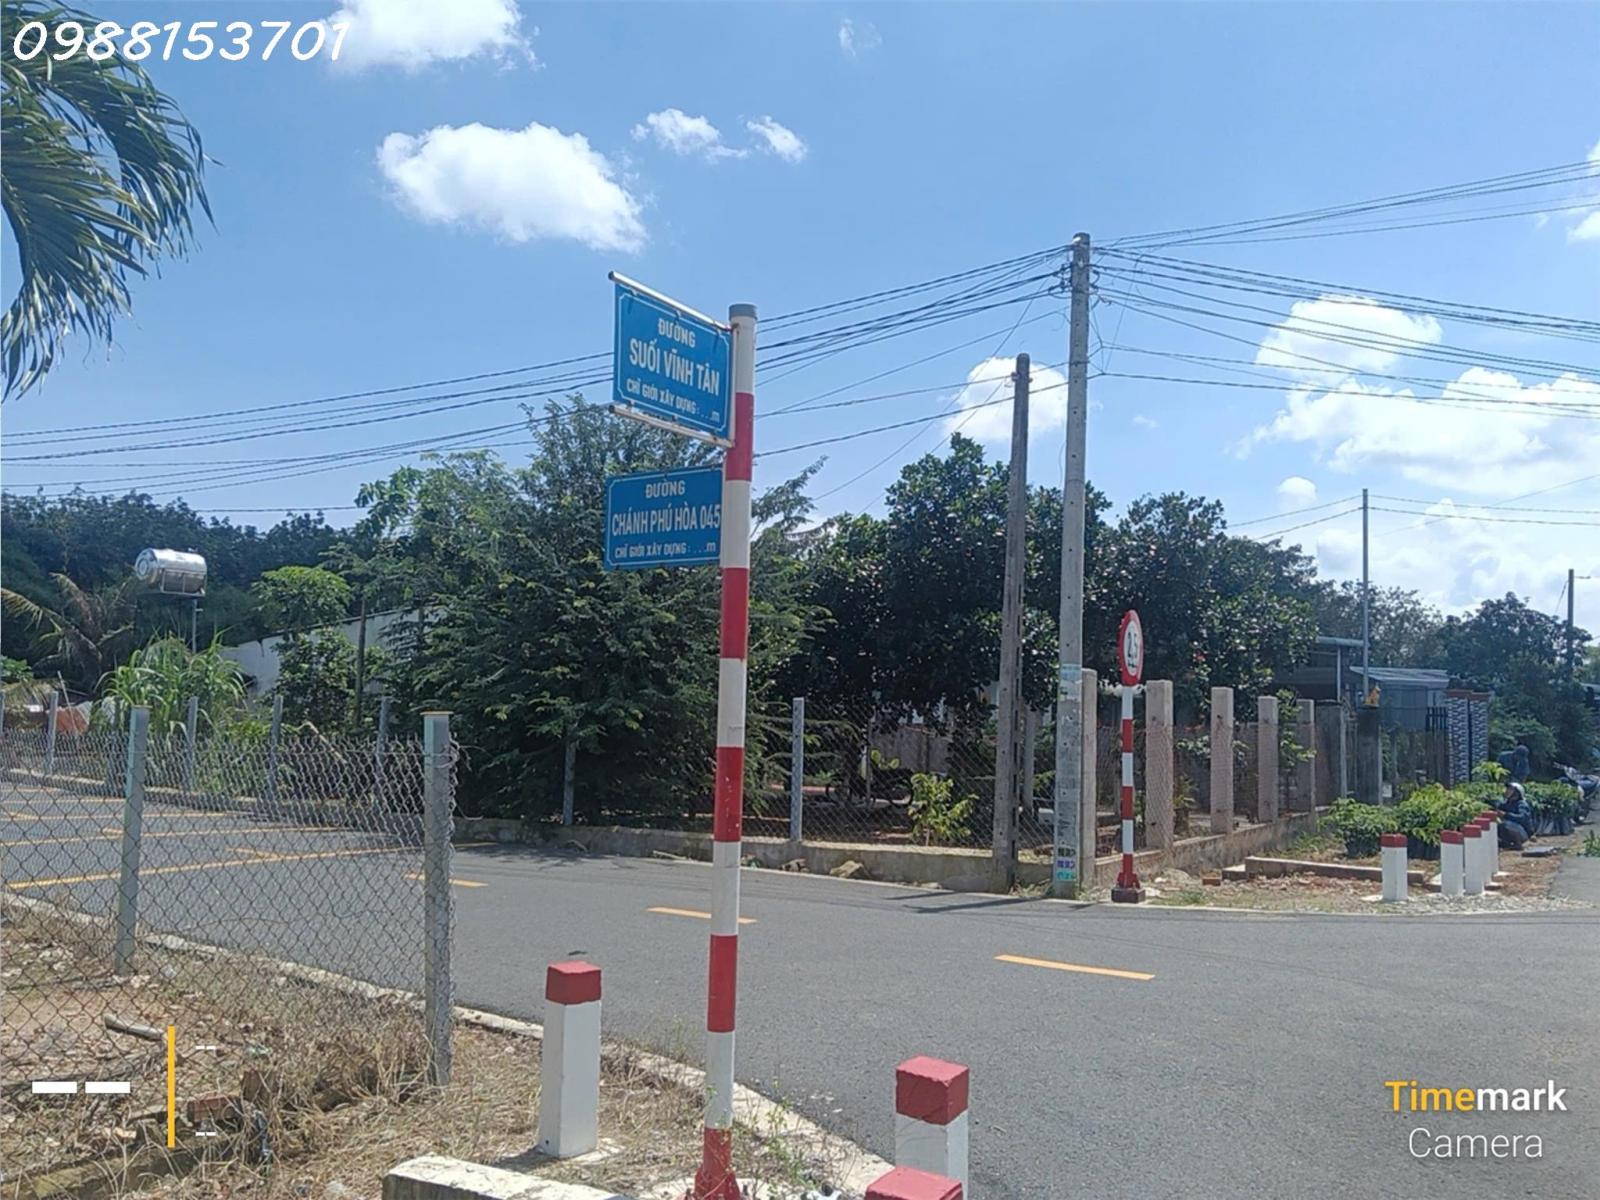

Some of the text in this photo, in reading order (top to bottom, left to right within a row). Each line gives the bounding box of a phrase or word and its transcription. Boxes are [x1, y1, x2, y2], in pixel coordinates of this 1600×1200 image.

[658, 318, 696, 348] ĐƯỜNG
[629, 338, 660, 375] SUỐI
[664, 349, 694, 388] VĨNH
[645, 479, 686, 499] ĐƯỜNG
[612, 501, 720, 536] CHÁNH PHÚ HÒA 045
[646, 542, 662, 556] XÂY
